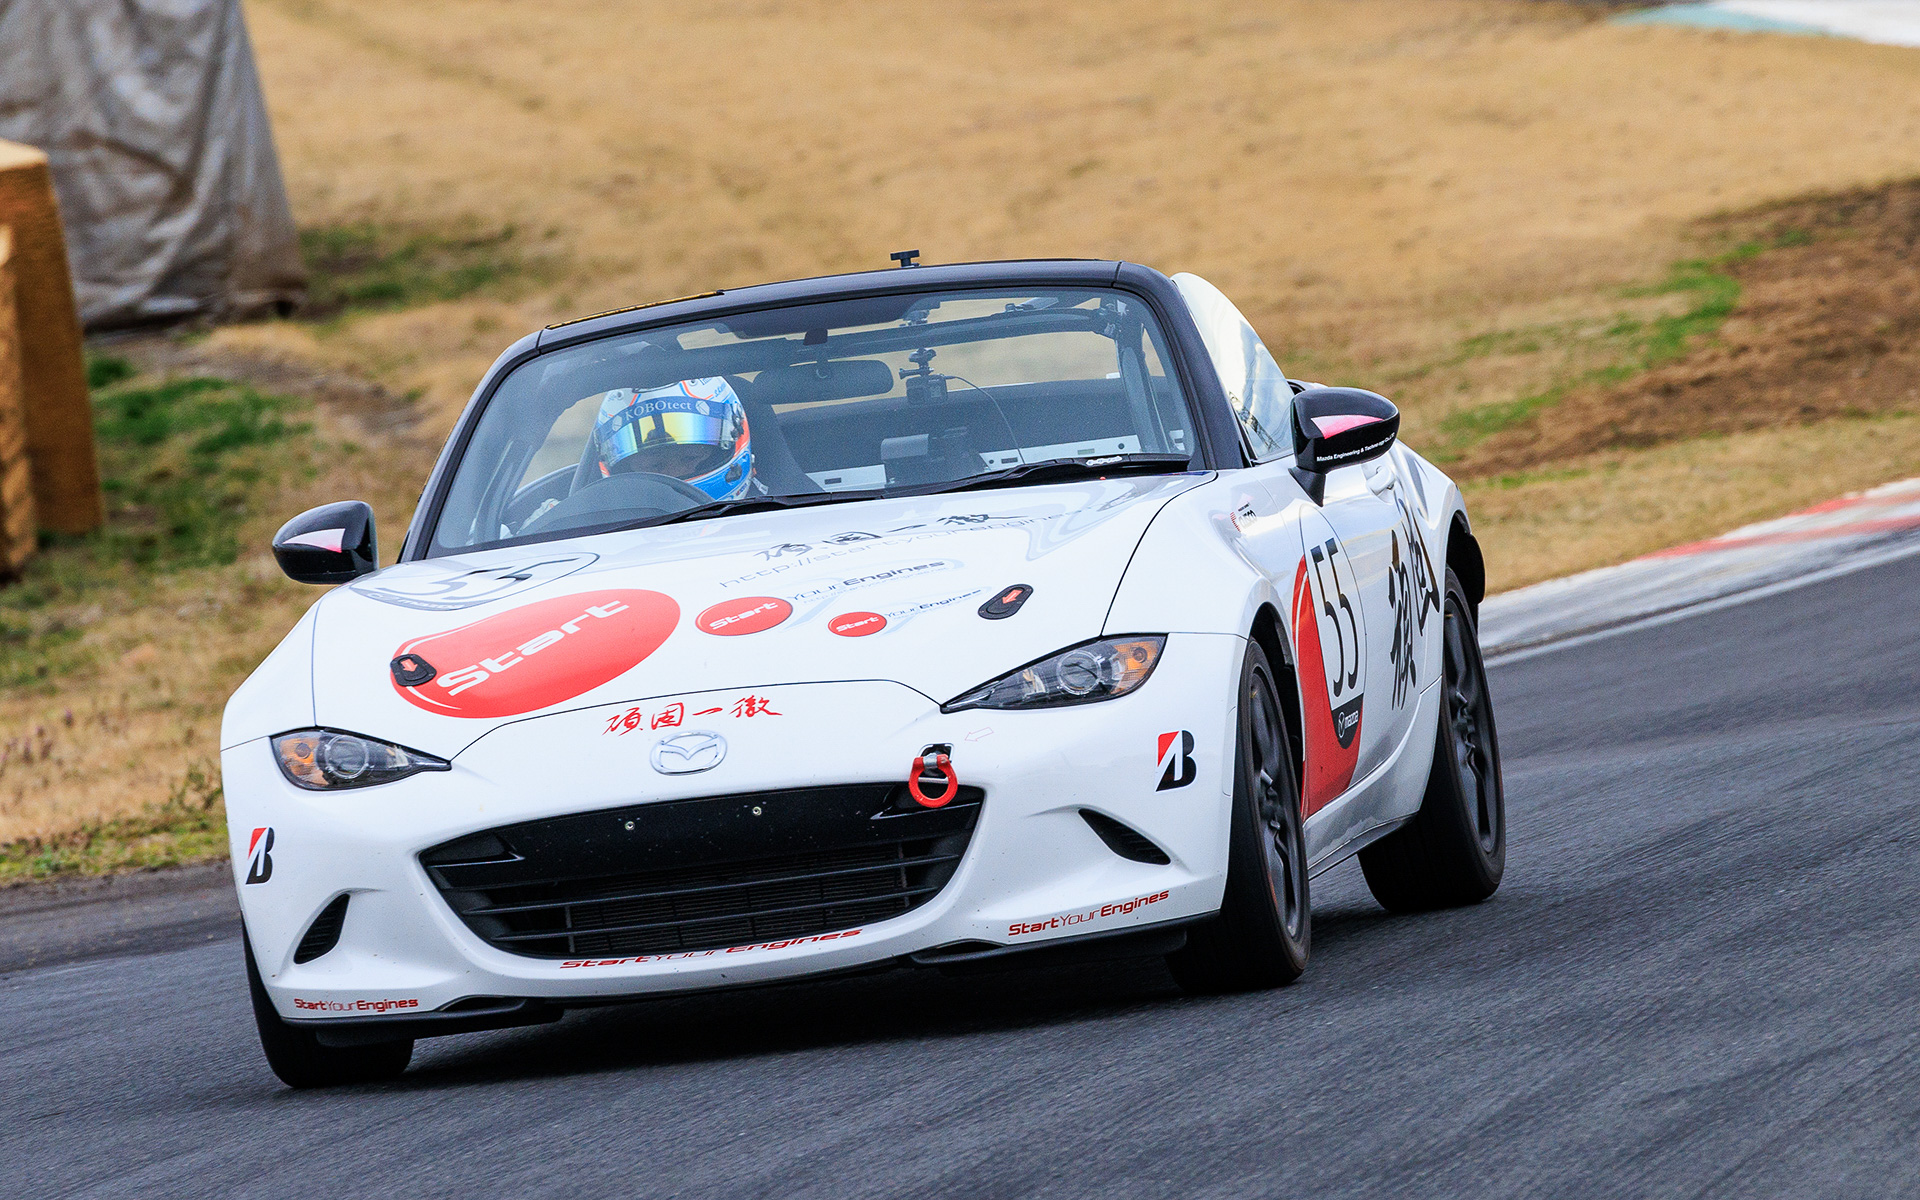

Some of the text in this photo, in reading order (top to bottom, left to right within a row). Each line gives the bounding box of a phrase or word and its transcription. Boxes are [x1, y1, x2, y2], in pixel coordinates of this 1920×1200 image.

[625, 400, 692, 421] KOBOtect
[1333, 448, 1361, 459] Engineering
[375, 557, 581, 600] 55
[709, 601, 779, 631] Start
[836, 616, 880, 633] Start
[1310, 537, 1359, 698] 55
[437, 600, 630, 697] Start
